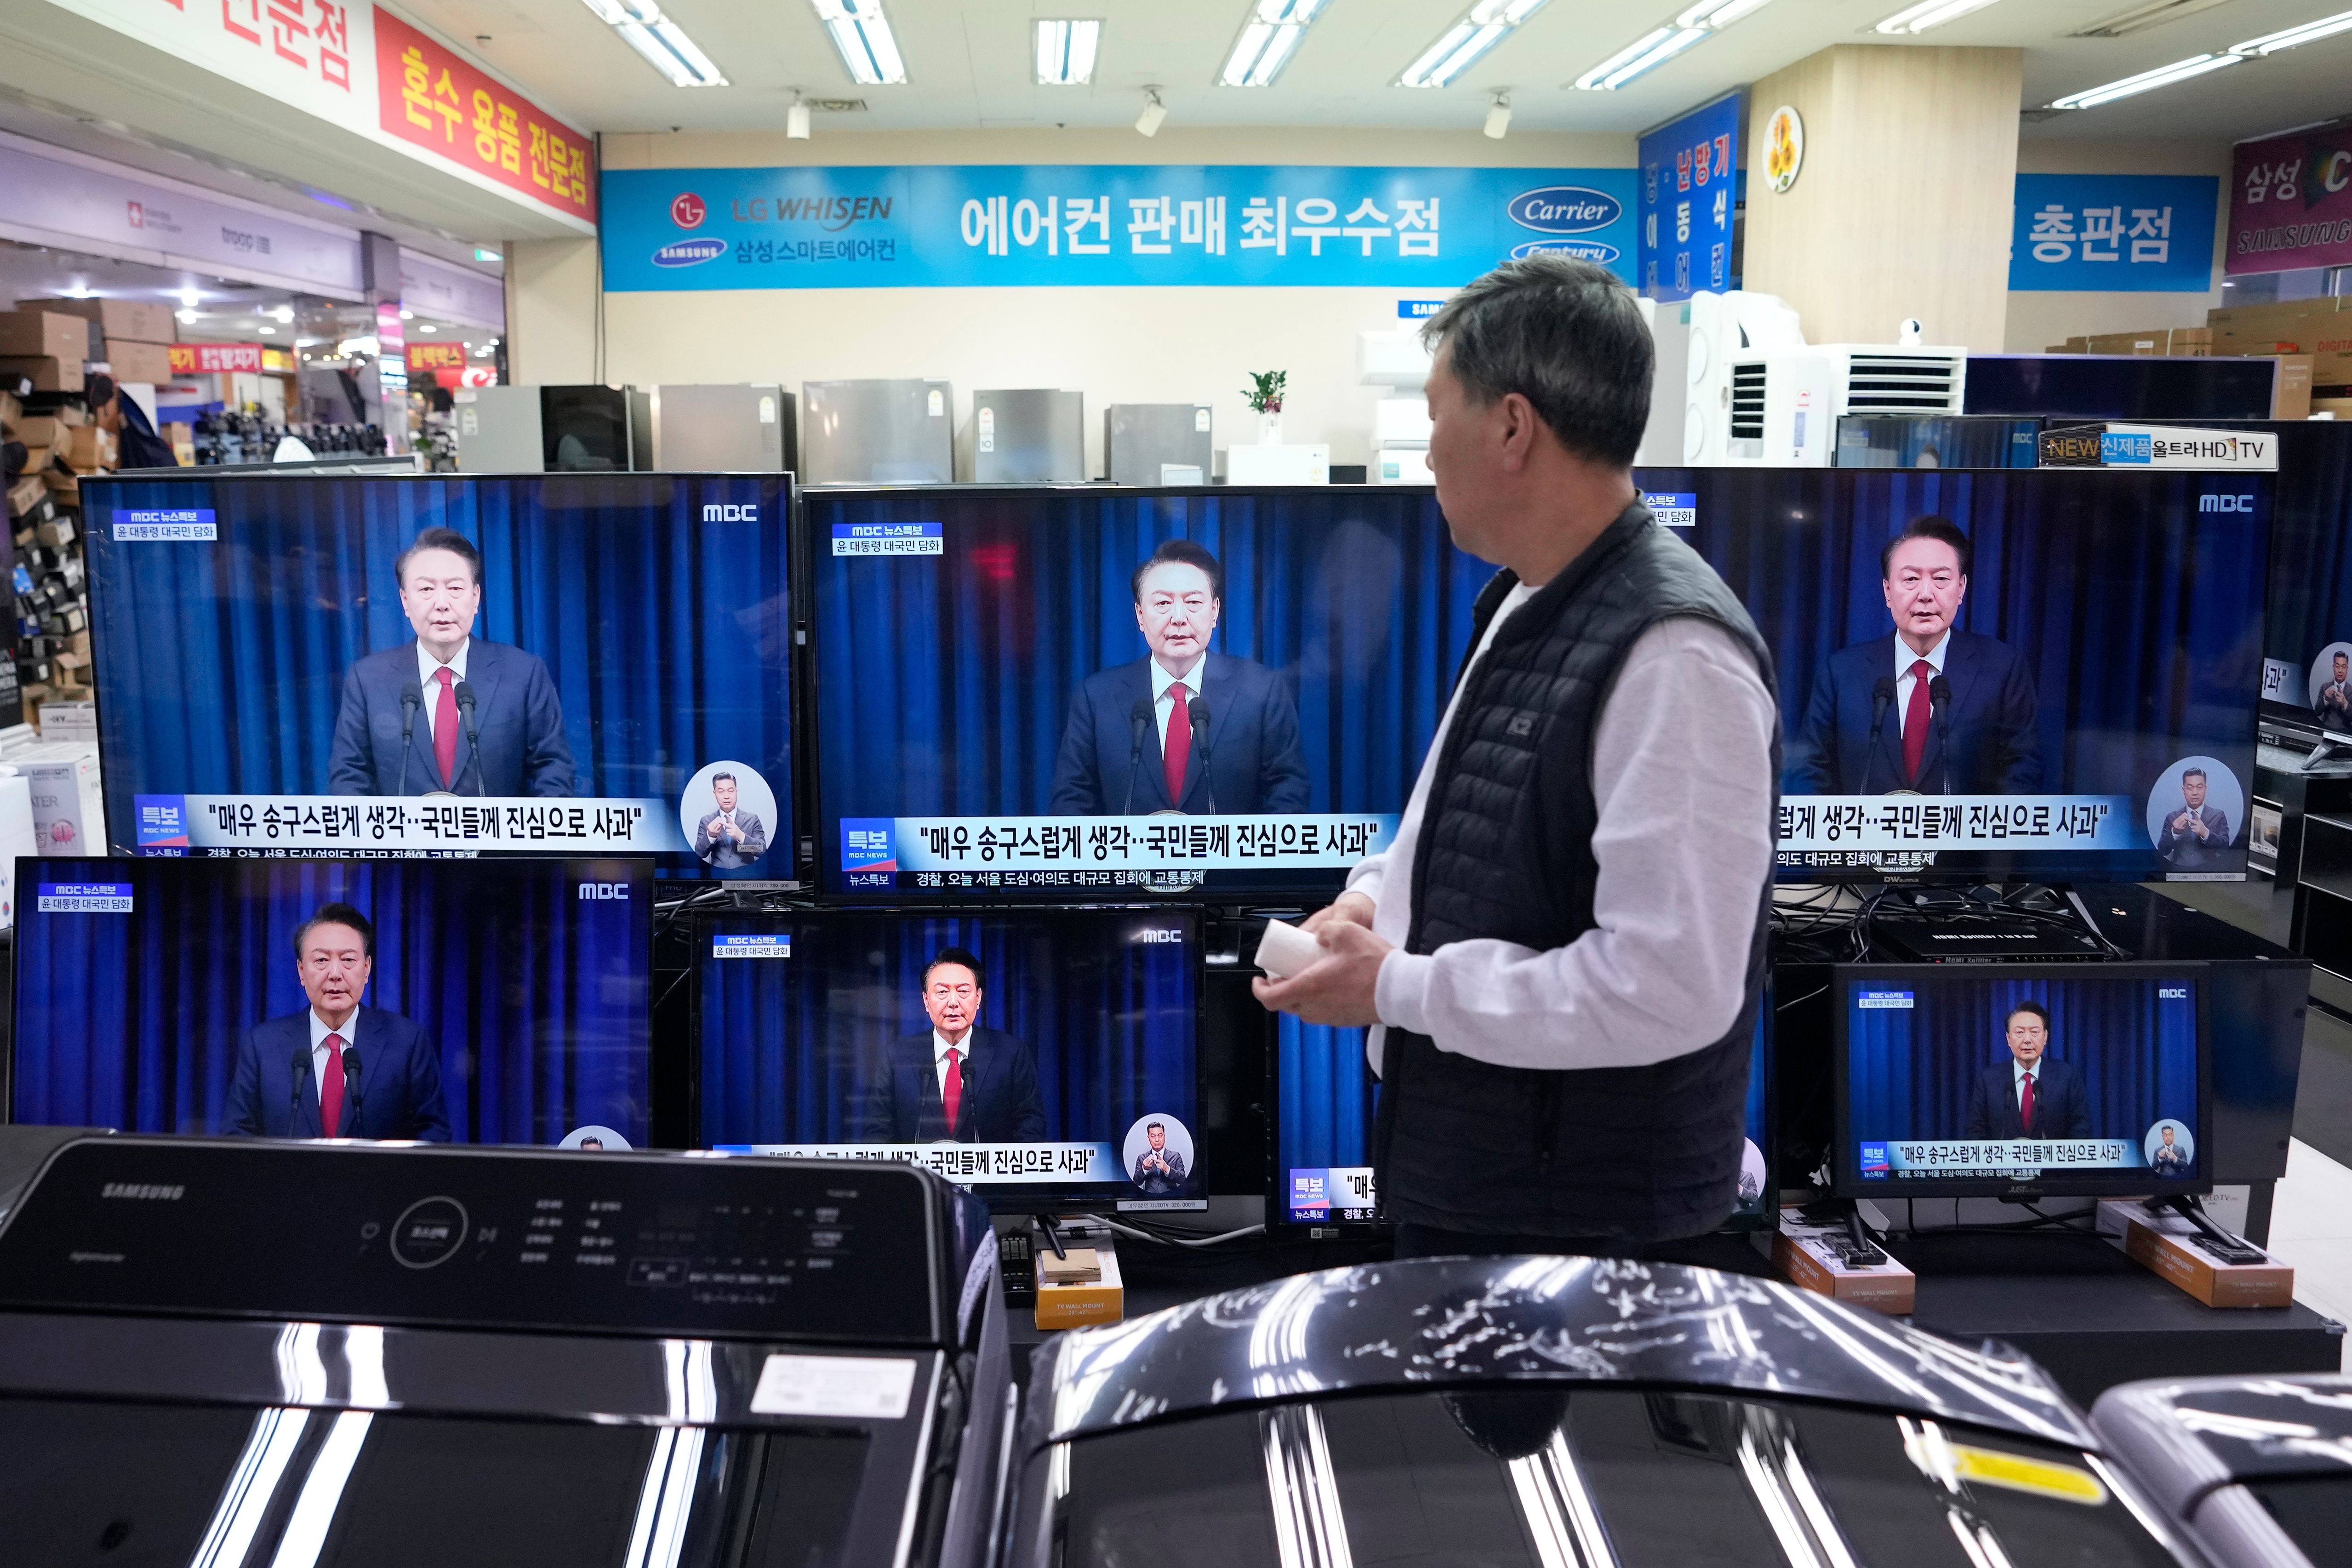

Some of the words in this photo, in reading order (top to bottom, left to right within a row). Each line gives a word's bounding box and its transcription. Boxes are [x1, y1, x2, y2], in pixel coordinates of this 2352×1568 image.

[401, 47, 462, 143] 혼수
[472, 90, 521, 176] 용품
[529, 121, 587, 206] 전문점
[2245, 158, 2301, 205] 삼성
[732, 198, 767, 221] LG
[776, 197, 893, 231] WHISEN
[1524, 200, 1609, 220] Carrier
[961, 196, 1110, 256] 에어컨
[1127, 196, 1226, 256] 판매
[1239, 196, 1440, 257] 최우수점
[2029, 205, 2172, 263] 총판점
[2237, 219, 2352, 254] SAMSUNG
[660, 247, 717, 259] SAMSUNG
[1411, 303, 1444, 315] SAM
[2049, 439, 2098, 456] NEW
[2101, 436, 2151, 459] 신제품
[2240, 442, 2263, 458] TV
[2199, 495, 2253, 512] MBC
[131, 513, 159, 521] MBC
[161, 512, 197, 521] 뉴스특보
[703, 505, 757, 521] MBC
[1672, 511, 1691, 522] 담화
[118, 526, 126, 537] 윤
[130, 527, 158, 537] 대통령
[162, 527, 190, 536] 대국민
[194, 527, 213, 536] 담화
[852, 526, 882, 536] MBC
[885, 525, 922, 536] 뉴스특보
[837, 541, 846, 552] 윤
[851, 541, 880, 552] 대통령
[885, 541, 914, 551] 대국민
[919, 540, 939, 551] 담화
[143, 807, 179, 825] 특보
[209, 804, 256, 836] "매우
[263, 804, 360, 838] 송구스럽게
[507, 807, 586, 839] 진심으로
[593, 808, 641, 840] 사과"
[1969, 805, 2049, 838] 진심으로
[2056, 805, 2107, 838] 사과"
[849, 831, 887, 849] 특보
[921, 827, 970, 860] "매우
[978, 826, 1080, 861] 송구스럽게
[1237, 824, 1319, 856] 진심으로
[1326, 823, 1376, 856] 사과"
[1805, 852, 1842, 866] 대규모
[1845, 852, 1882, 866] 집회에
[1885, 852, 1934, 866] 교통통제
[850, 874, 889, 886] 뉴스특보
[917, 872, 944, 886] 경찰,
[948, 872, 973, 886] 오늘
[976, 872, 1001, 886] 서울
[1004, 872, 1070, 886] 도심·여의도
[1073, 872, 1110, 885] 대규모
[1114, 871, 1151, 885] 집회에
[1154, 871, 1204, 884] 교통통제
[83, 886, 115, 894] 뉴스특보
[579, 884, 628, 899] MBC
[42, 899, 50, 908] 윤
[54, 899, 79, 909] 대통령
[83, 899, 108, 909] 대국민
[112, 899, 129, 909] 담화
[1142, 929, 1181, 942] MBC
[2159, 989, 2186, 998] MBC
[1864, 1149, 1884, 1158] 특보
[1901, 1146, 1925, 1163] "매우
[1929, 1146, 1979, 1164] 송구스럽게
[2056, 1145, 2096, 1162] 진심으로
[2101, 1145, 2125, 1161] 사과"
[994, 1149, 1054, 1175] 진심으로
[1058, 1148, 1095, 1174] 사과"
[102, 1183, 184, 1200] SAMSUNG
[1296, 1178, 1323, 1192] 특보
[1295, 1210, 1324, 1220] 뉴스특보
[1344, 1209, 1364, 1220] 경찰,
[1791, 1252, 1803, 1267] WALL
[1803, 1260, 1821, 1280] MOUNT
